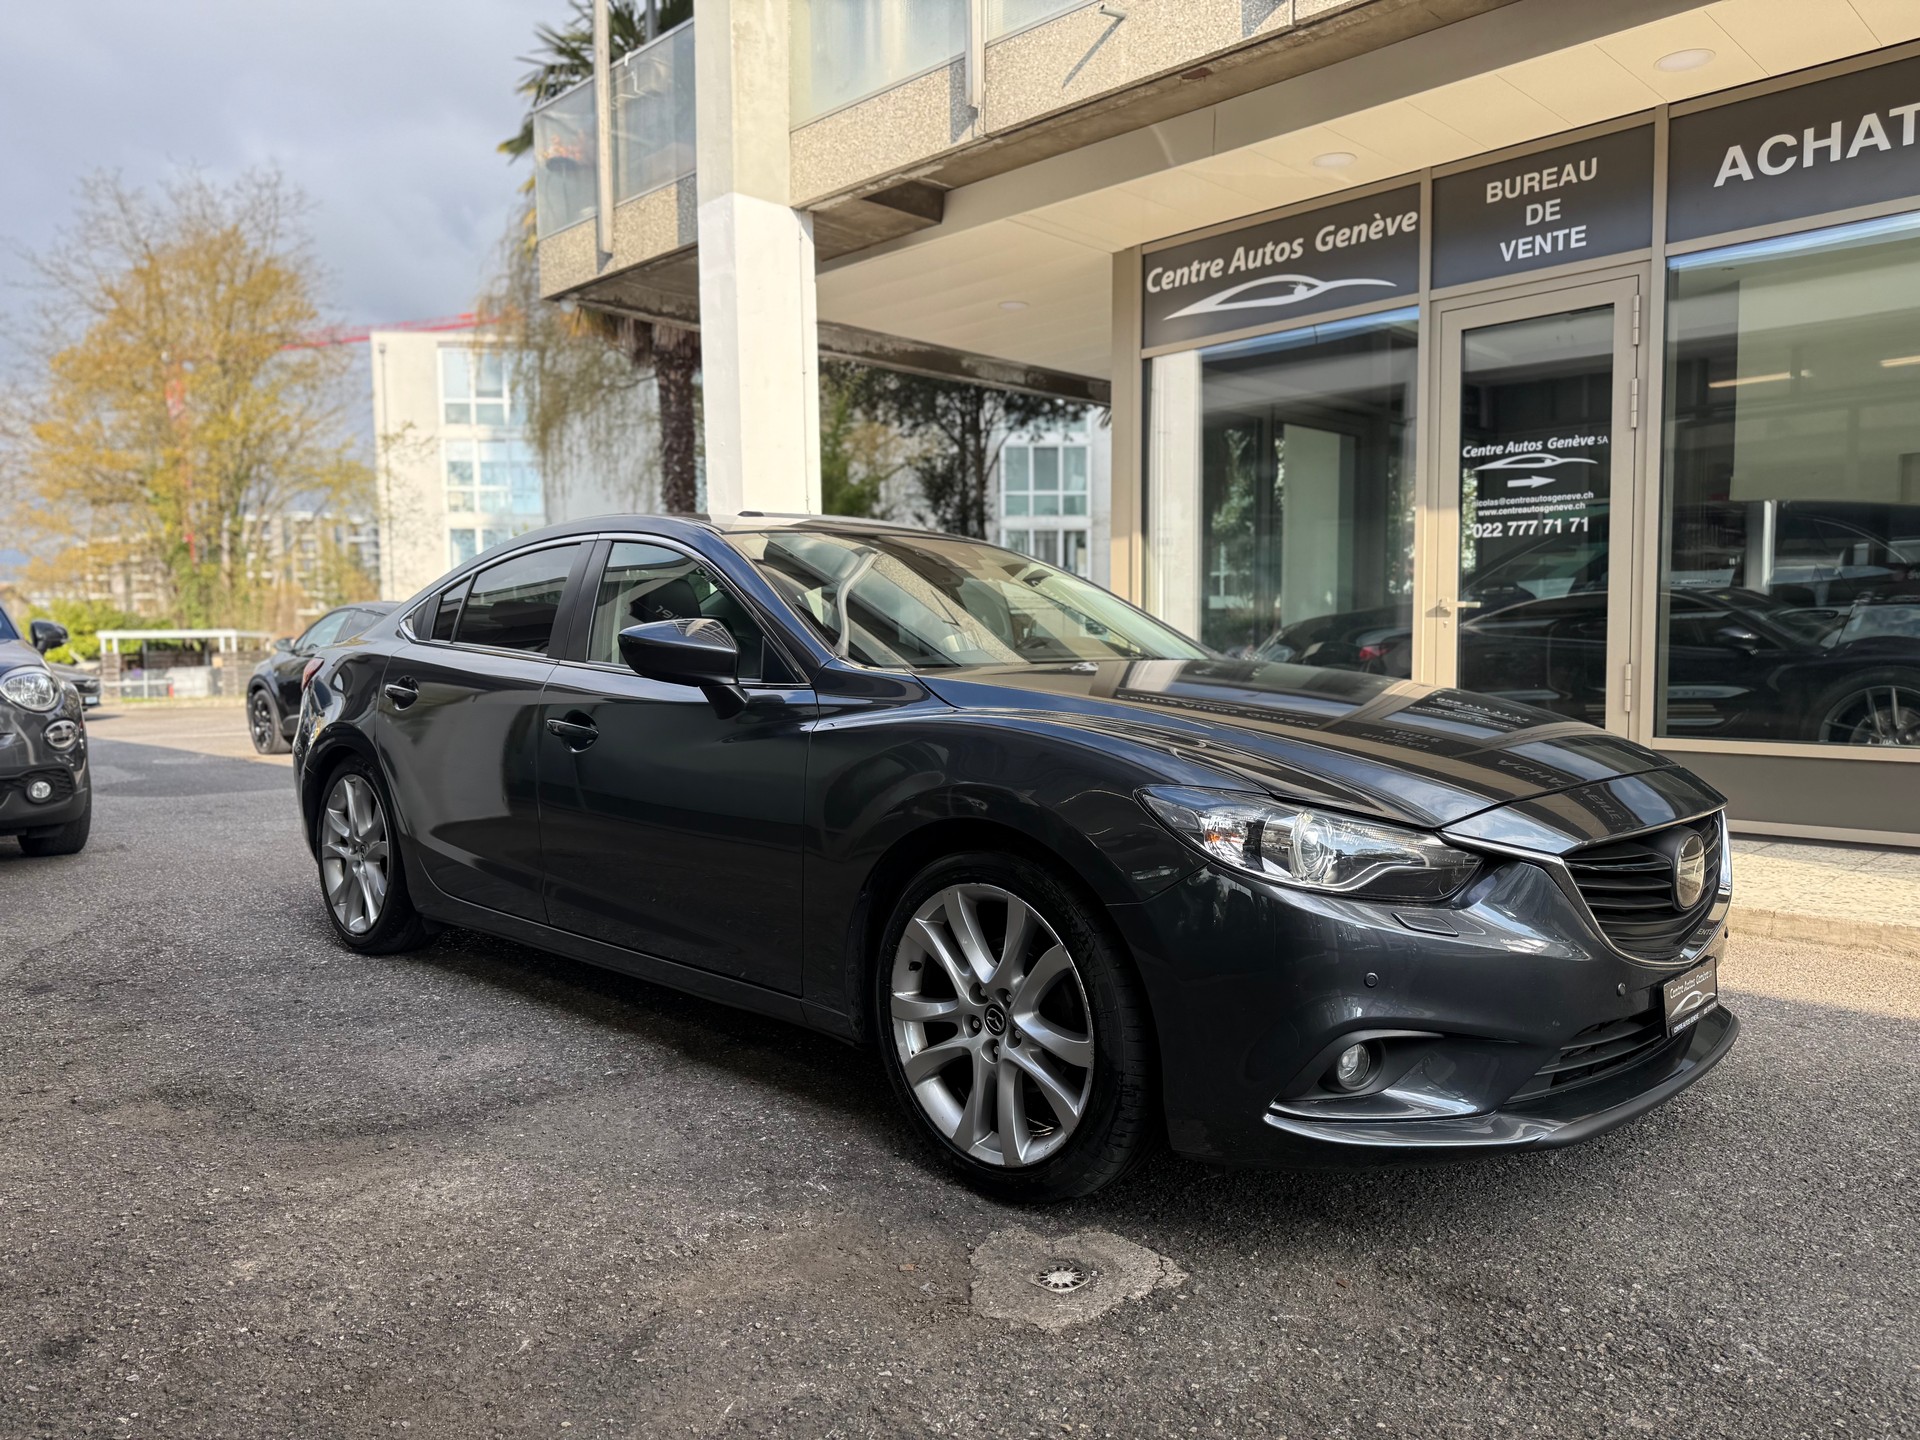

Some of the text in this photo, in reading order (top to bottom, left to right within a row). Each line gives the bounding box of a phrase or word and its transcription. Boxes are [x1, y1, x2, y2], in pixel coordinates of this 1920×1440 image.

[1713, 102, 1920, 188] ACHAT
[1486, 157, 1597, 204] BUREAU
[1526, 198, 1561, 226] DE
[1146, 211, 1418, 294] Centre Autos Genève
[1500, 225, 1587, 262] VENTE
[1462, 434, 1609, 458] Centre Autos Genève SA
[1478, 502, 1586, 517] www.centreautosgeneve.ch
[1473, 516, 1589, 539] 022 777 71 71
